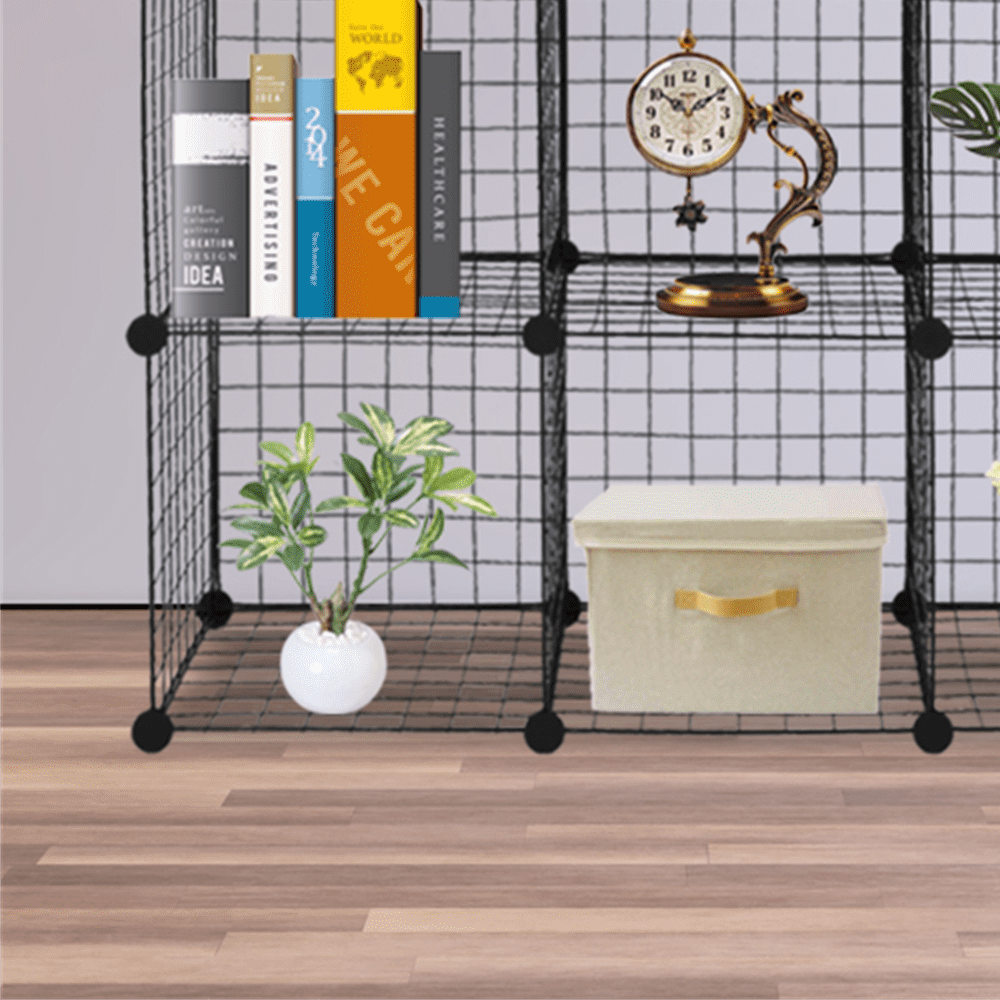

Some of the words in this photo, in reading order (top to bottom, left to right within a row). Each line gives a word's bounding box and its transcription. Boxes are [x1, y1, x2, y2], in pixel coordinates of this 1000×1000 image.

[349, 32, 404, 45] WORLD
[664, 74, 675, 88] 11
[682, 70, 697, 82] 12
[645, 106, 656, 120] 9
[720, 106, 730, 120] 3
[650, 124, 661, 139] 8
[665, 138, 675, 152] 7
[683, 143, 694, 157] 6
[702, 138, 713, 152] 5
[336, 136, 382, 206] WE
[433, 116, 445, 243] HEALTHCARE
[263, 162, 278, 283] ADVERTISING
[183, 238, 235, 248] CREATION
[183, 251, 238, 262] DESIGN
[183, 264, 225, 286] IDEA
